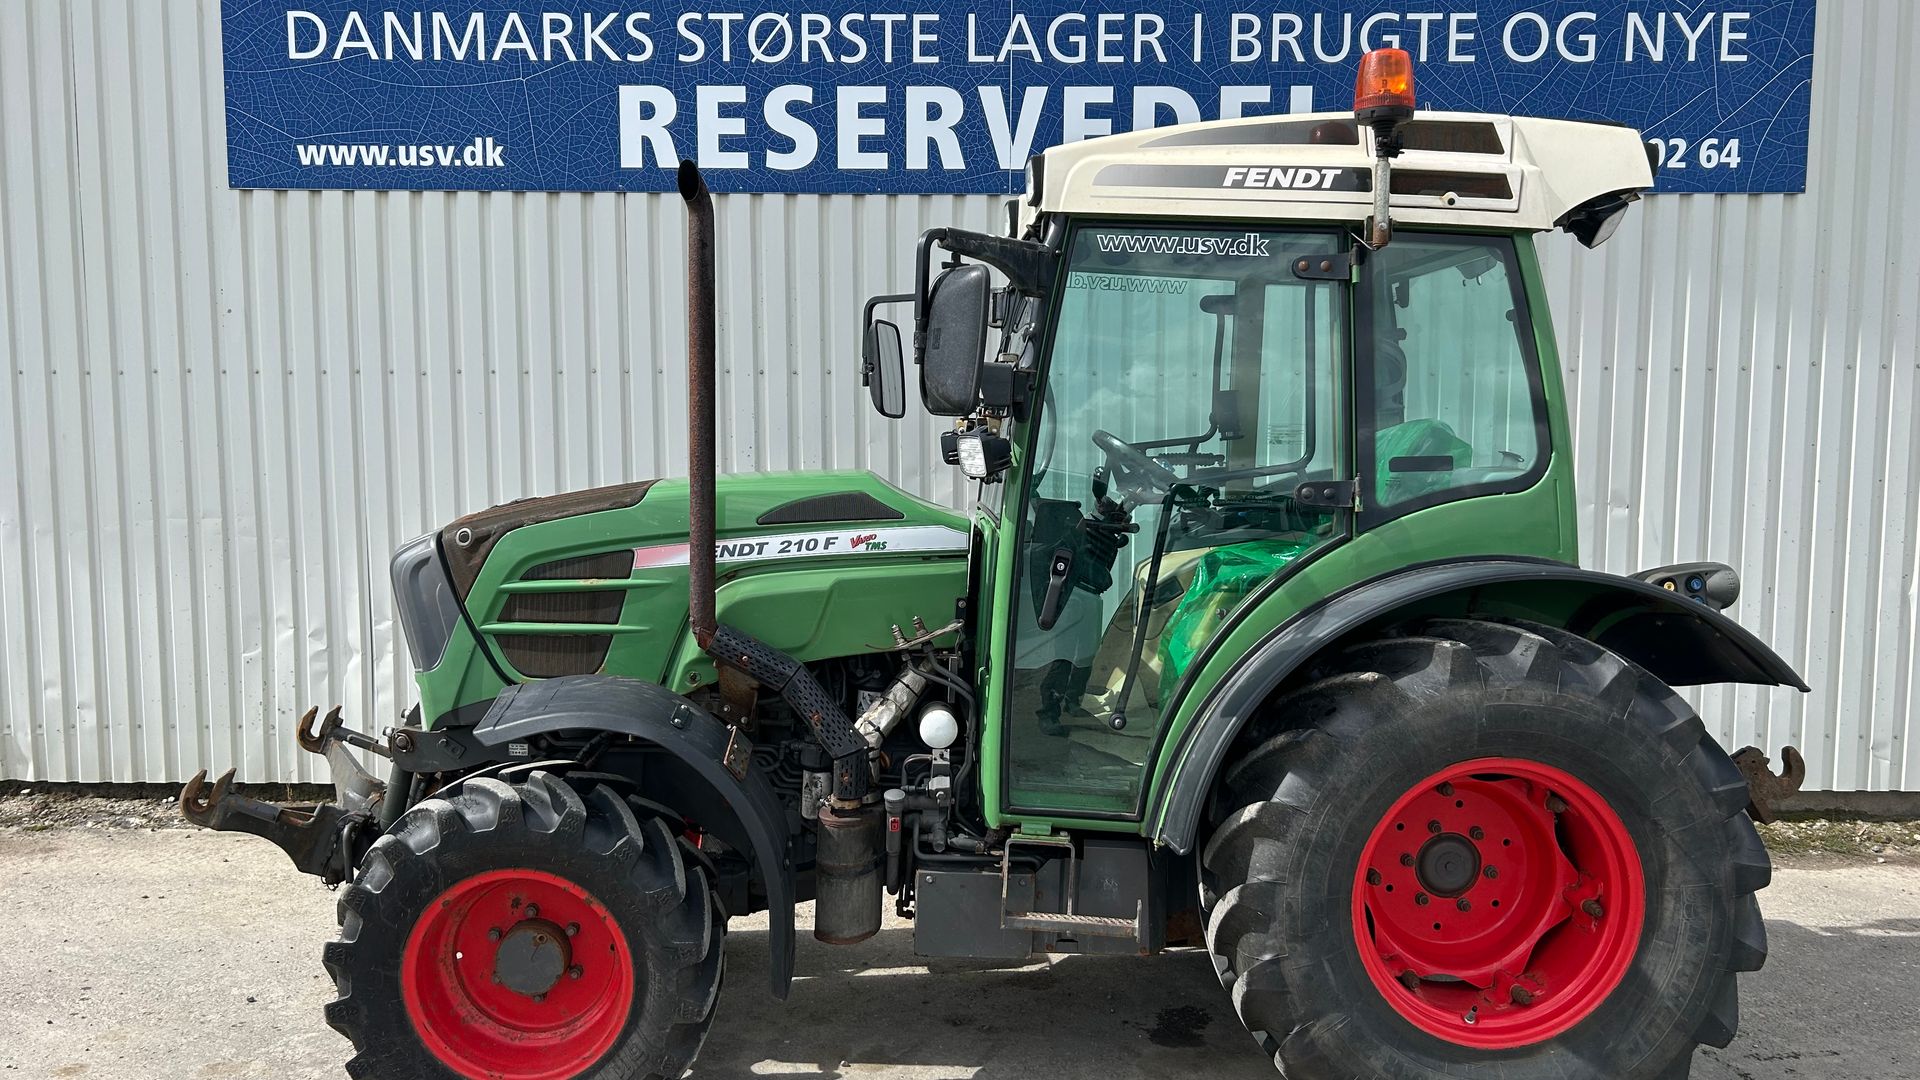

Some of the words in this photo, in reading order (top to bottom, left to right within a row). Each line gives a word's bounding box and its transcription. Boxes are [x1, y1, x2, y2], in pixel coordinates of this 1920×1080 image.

[287, 11, 653, 62] DANMARKS
[677, 11, 940, 63] STØRSTE
[969, 13, 1166, 64] LAGER
[1194, 14, 1202, 62] I
[1231, 12, 1477, 66] BRUGTE
[1503, 12, 1596, 63] OG
[1626, 11, 1750, 62] NYE
[297, 137, 504, 167] www.usv.dk
[1699, 138, 1741, 168] 64
[1222, 168, 1342, 188] FENDT
[1097, 233, 1269, 256] www.usv.dk
[777, 538, 818, 554] 210
[823, 536, 839, 550] F
[865, 541, 887, 550] TMS
